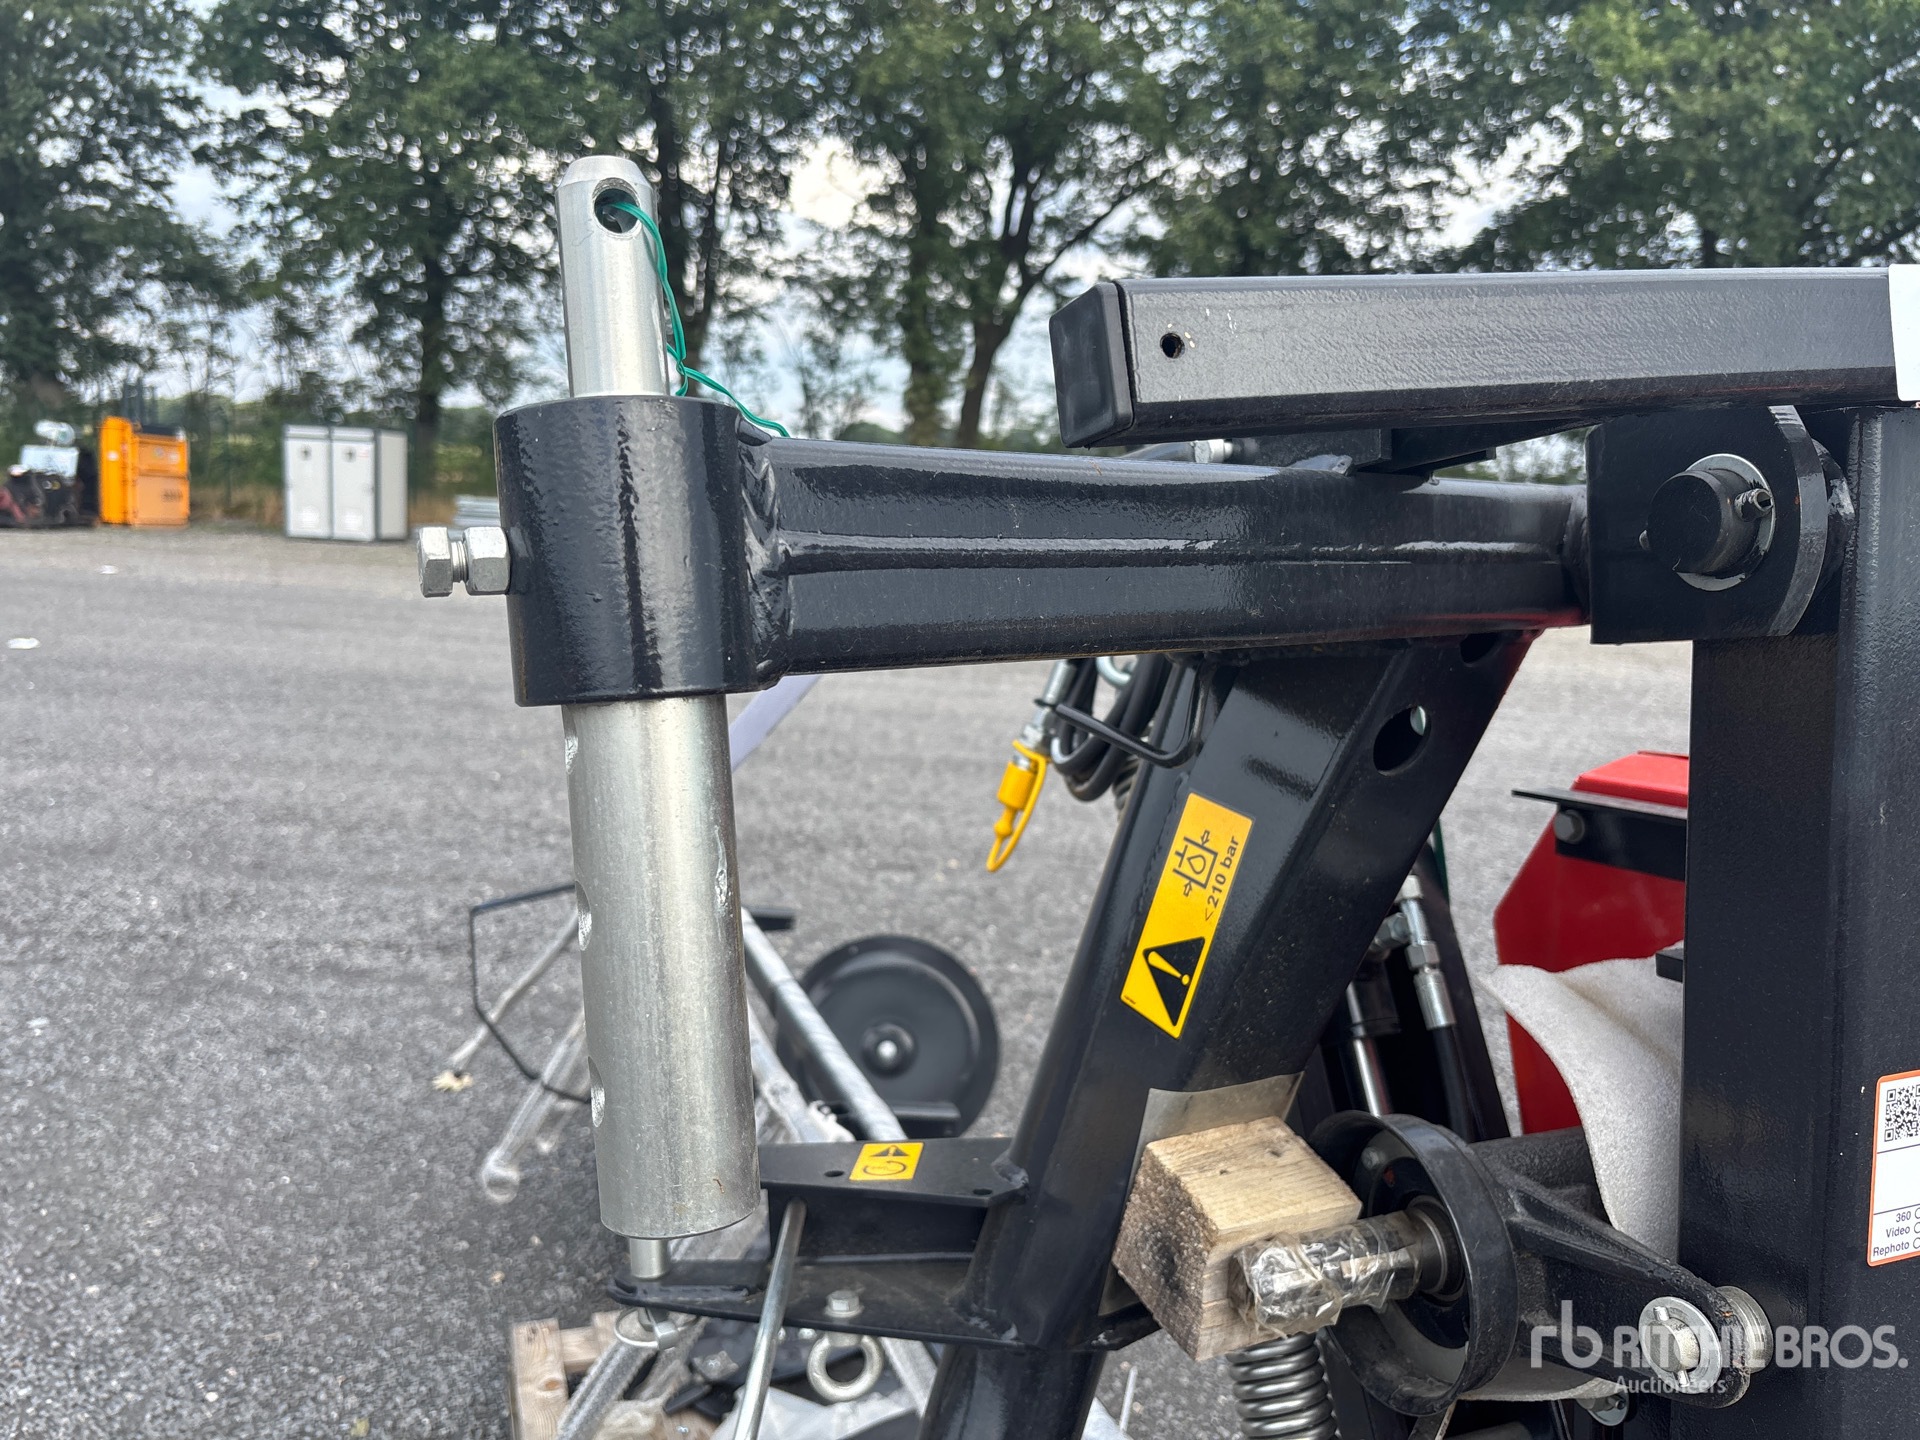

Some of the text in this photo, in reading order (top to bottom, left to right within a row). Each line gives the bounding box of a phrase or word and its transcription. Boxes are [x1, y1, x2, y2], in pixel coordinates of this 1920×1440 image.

[1220, 835, 1239, 869] bar
[1895, 1210, 1912, 1223] 360
[1886, 1226, 1911, 1238] Video
[1873, 1241, 1910, 1257] Rephoto
